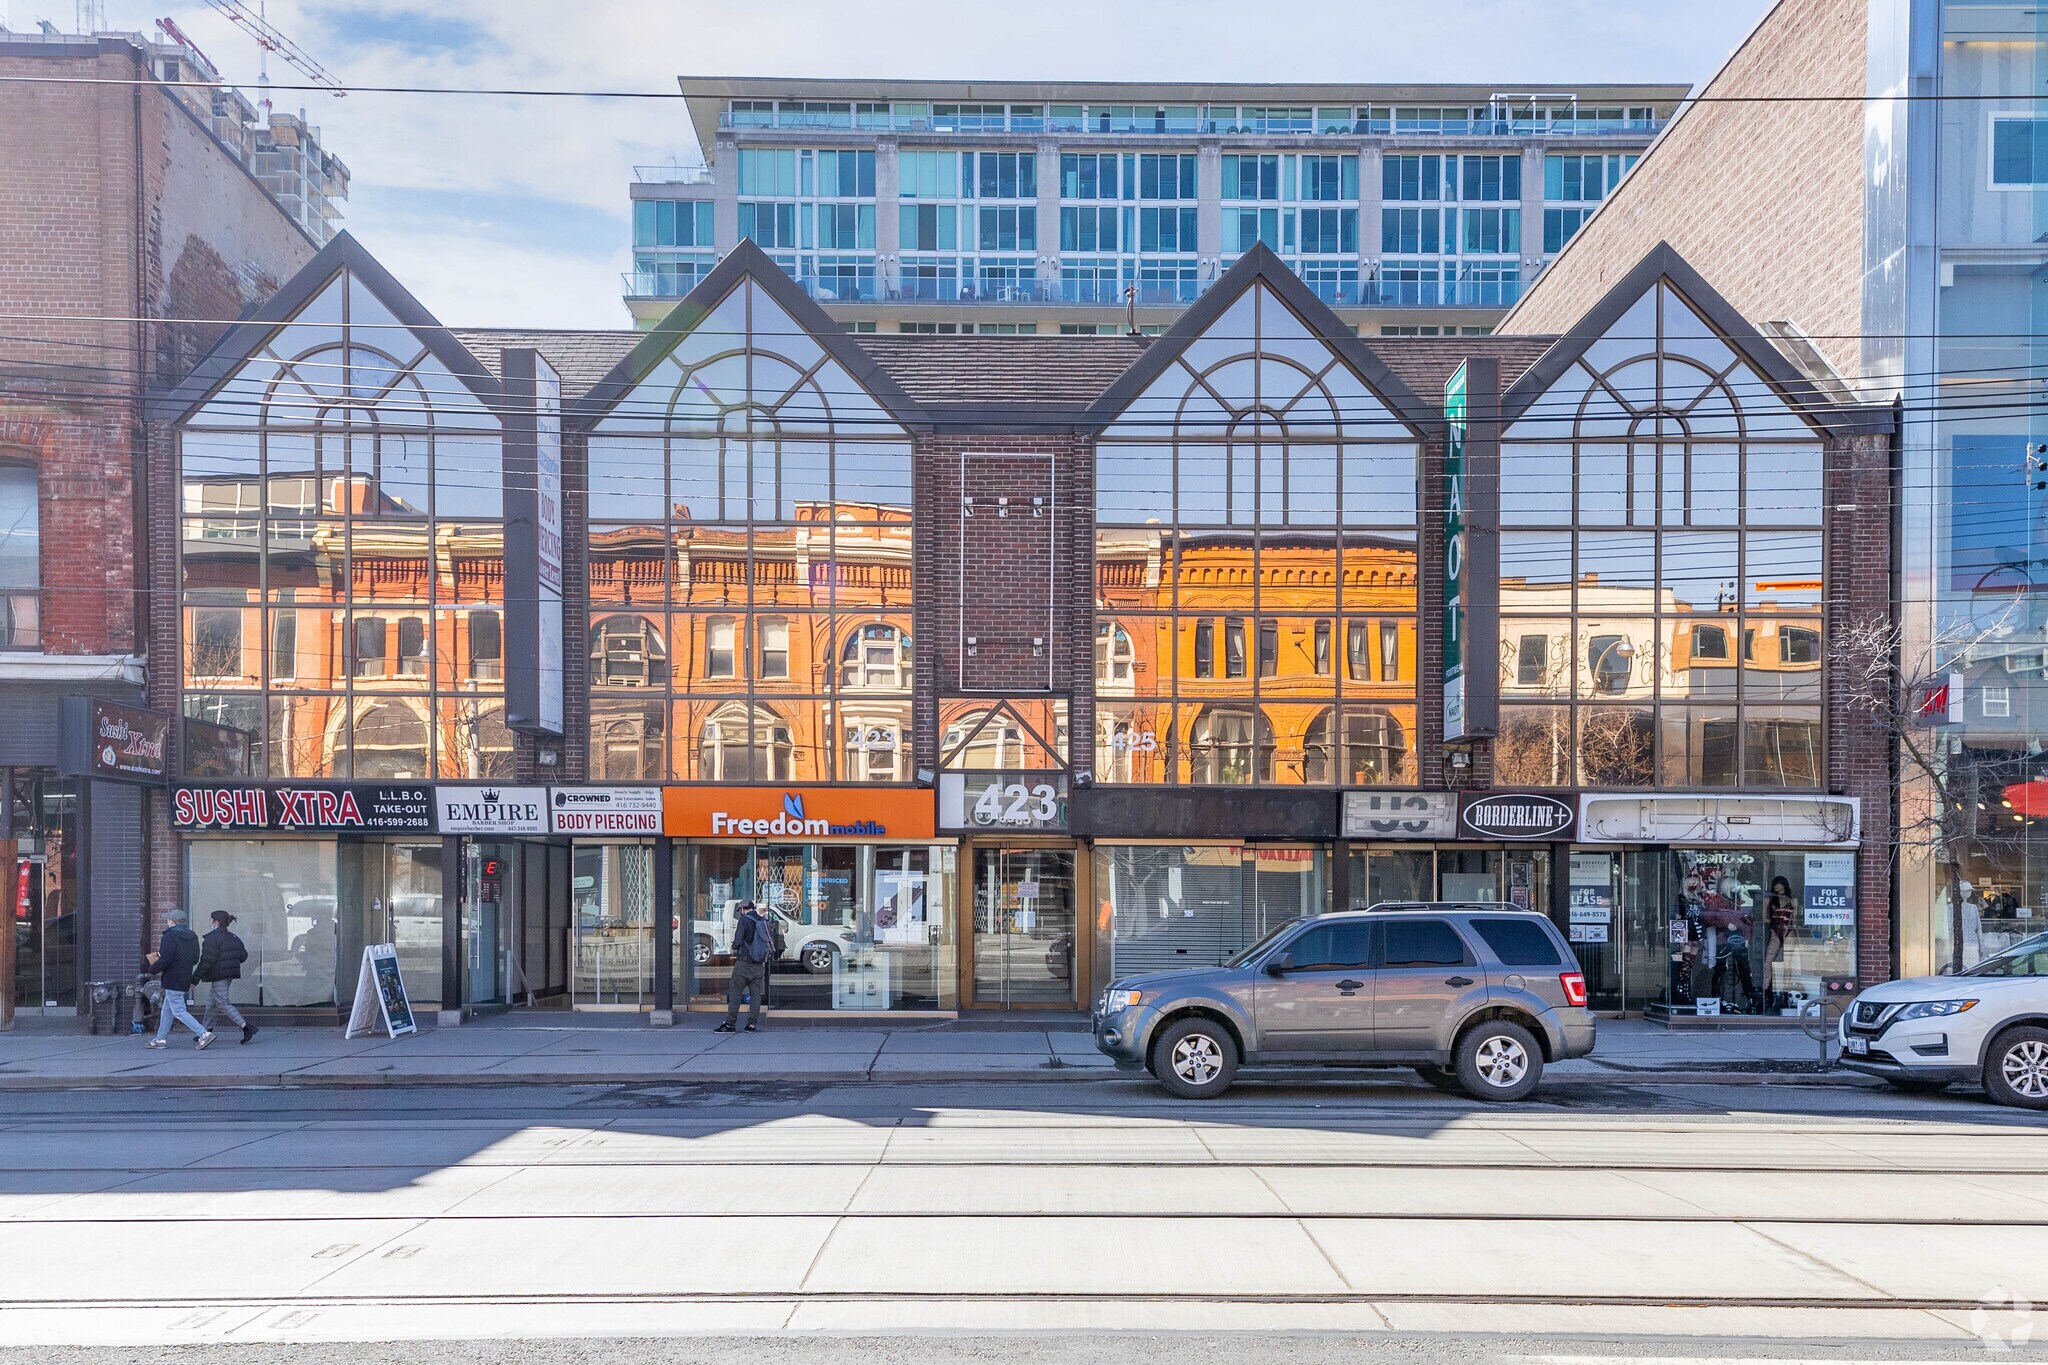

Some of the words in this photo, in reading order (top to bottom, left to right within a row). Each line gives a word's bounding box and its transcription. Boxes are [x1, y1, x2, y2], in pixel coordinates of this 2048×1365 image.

[1447, 403, 1463, 642] NAOT
[100, 716, 128, 740] Sushi
[124, 730, 161, 759] Xtra
[851, 730, 896, 750] 423
[1111, 731, 1156, 751] 425
[379, 791, 427, 801] L.L.B.O.
[567, 795, 611, 803] CROWNED
[975, 783, 1057, 821] 423
[175, 789, 267, 826] SUSHI
[275, 789, 365, 827] XTRA
[373, 804, 427, 814] TAKE-OUT
[445, 804, 539, 821] EMPIRE
[367, 817, 429, 827] 416-599-2688
[557, 814, 592, 829] BODY
[595, 814, 657, 830] PIERCING
[712, 811, 829, 836] Freedom
[829, 820, 886, 836] mobile
[1571, 895, 1603, 905] LEASE
[1579, 888, 1595, 896] FOR
[1821, 888, 1838, 896] FOR
[1812, 897, 1846, 906] LEASE
